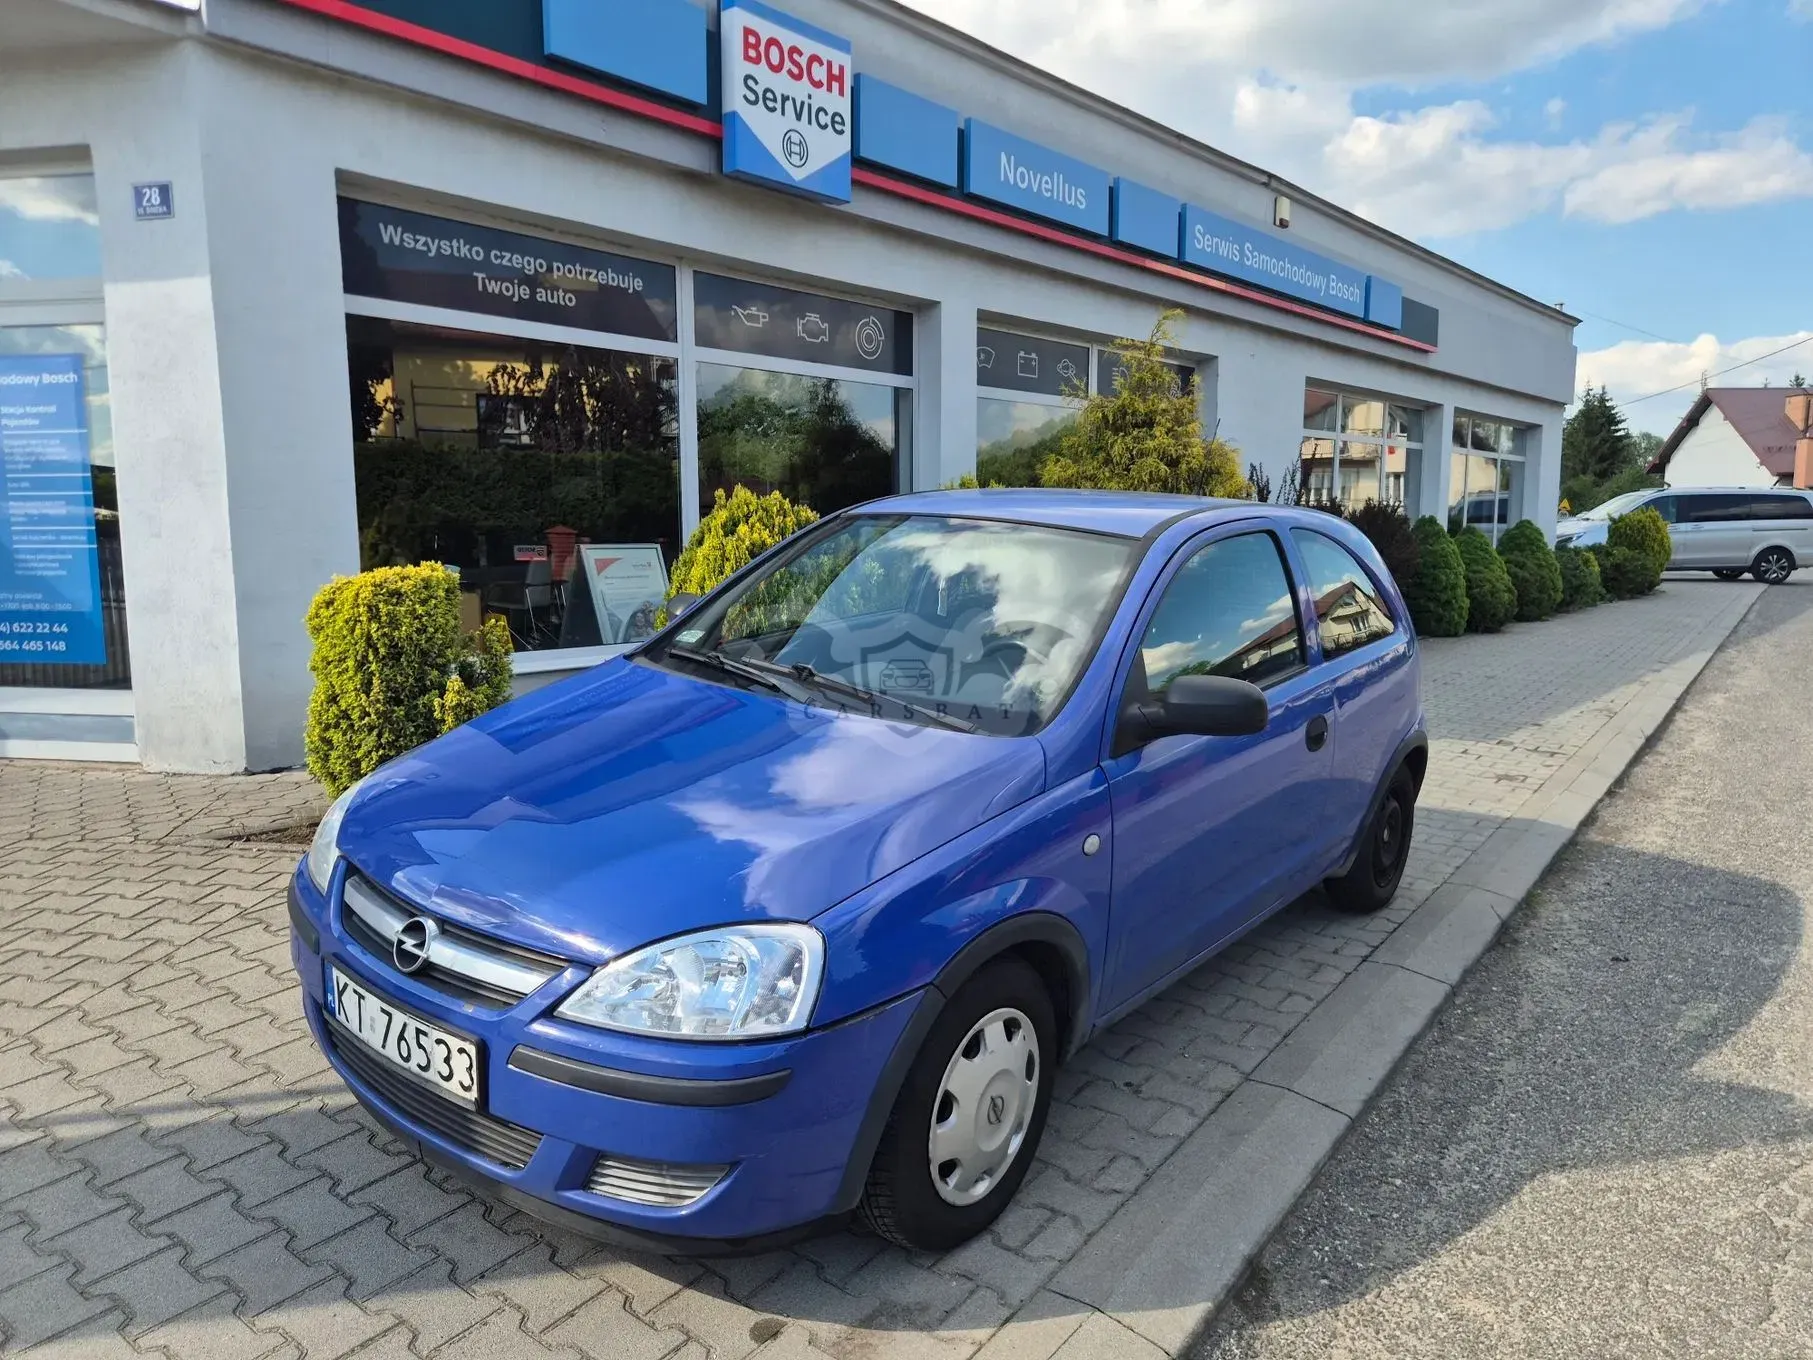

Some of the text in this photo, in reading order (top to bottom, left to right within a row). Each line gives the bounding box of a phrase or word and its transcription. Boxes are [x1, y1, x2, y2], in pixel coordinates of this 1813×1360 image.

[742, 26, 845, 98] BOSCH
[742, 74, 846, 136] Service
[142, 187, 160, 206] 28
[1000, 151, 1087, 210] Novellus
[378, 222, 643, 294] Wszystko czego potrzebuje
[1194, 225, 1360, 304] Serwis Samochodowy Bosch
[473, 272, 576, 308] Twoje auto
[41, 372, 78, 384] Bosch
[12, 622, 34, 633] 622
[36, 623, 50, 633] 22
[52, 623, 69, 633] 44
[22, 640, 44, 651] 465
[46, 641, 67, 652] 148
[336, 975, 475, 1093] KT 76533
